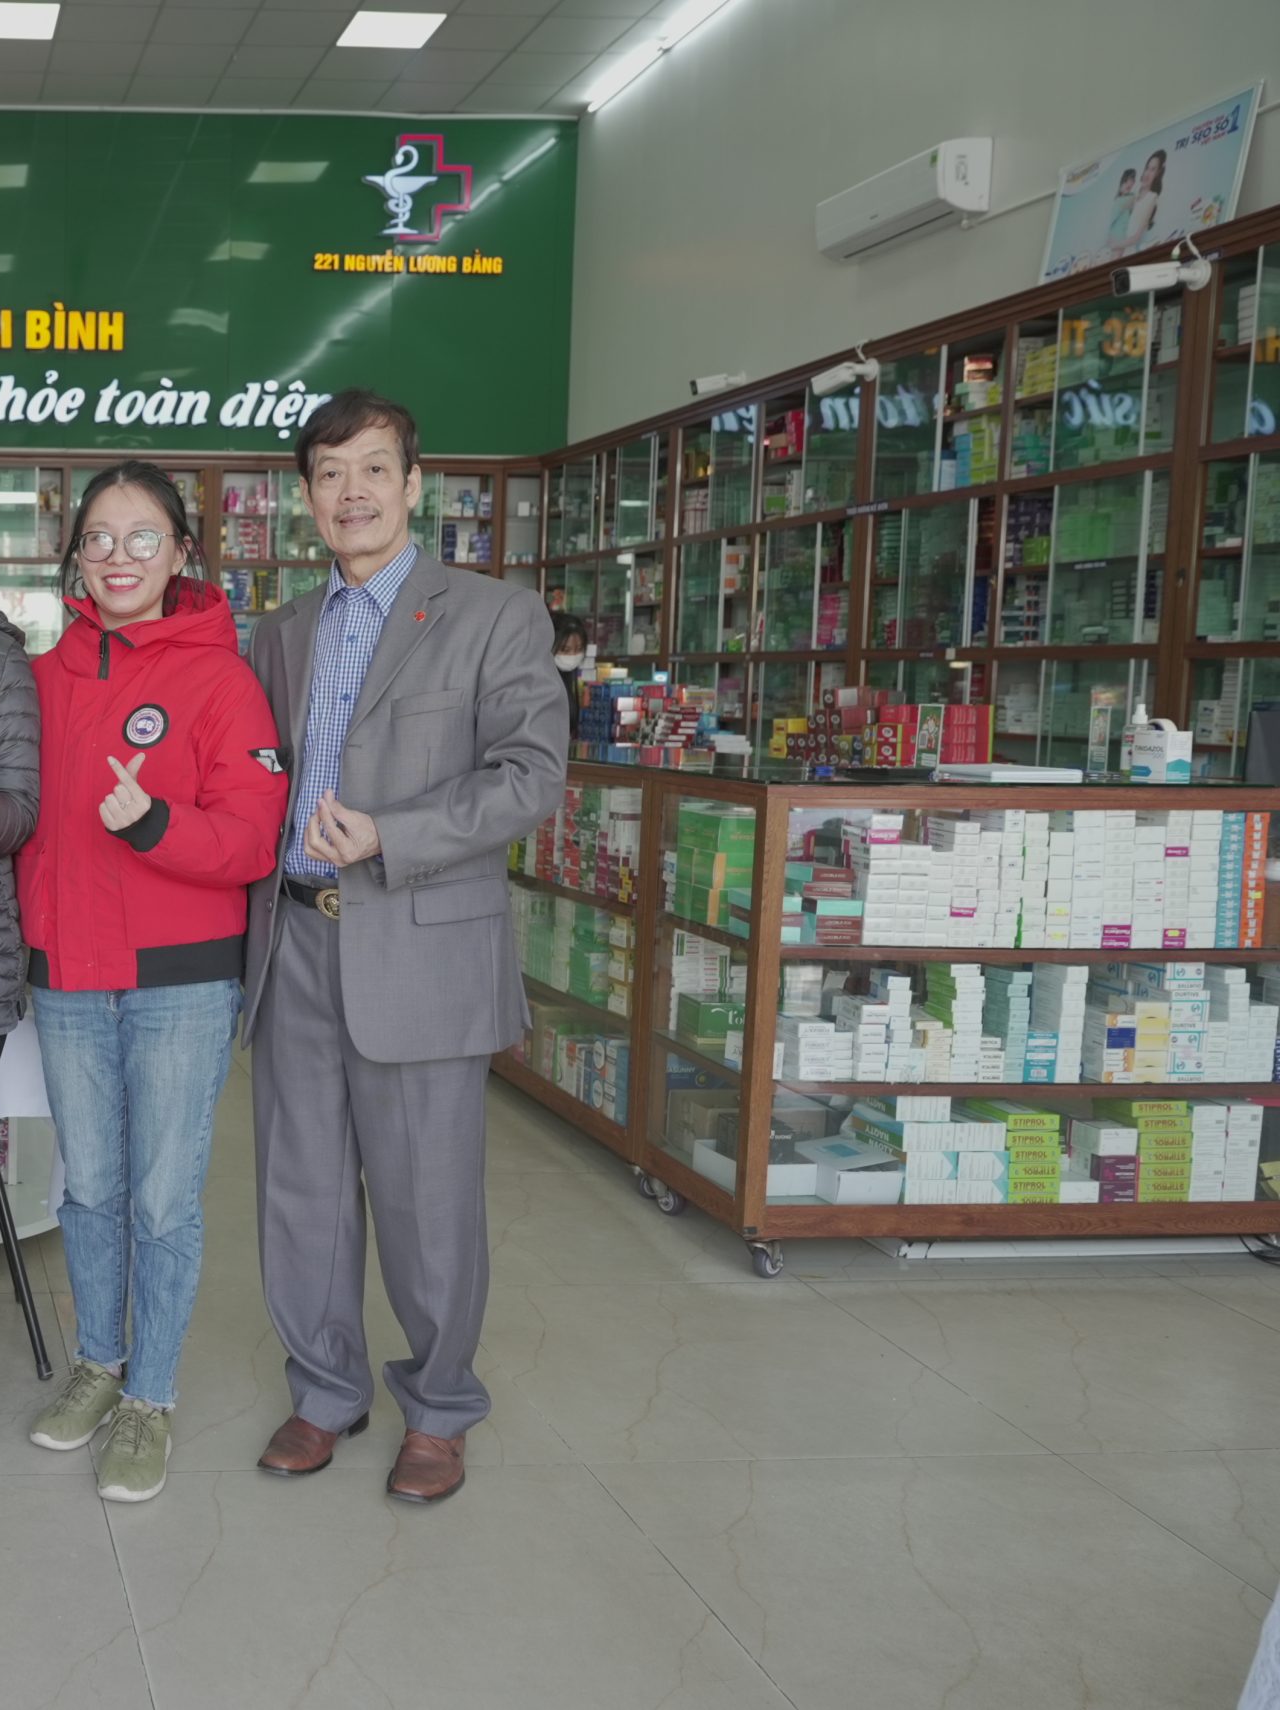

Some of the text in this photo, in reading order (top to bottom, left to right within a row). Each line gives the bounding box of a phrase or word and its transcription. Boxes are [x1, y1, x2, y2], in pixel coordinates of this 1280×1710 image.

[313, 253, 340, 270] 221
[25, 301, 125, 351] BÌNH
[94, 377, 211, 425] toàn
[1138, 1103, 1172, 1111] STIPROL
[1013, 1118, 1046, 1126] STIPROL
[1144, 1120, 1177, 1128] STIPROL
[1012, 1135, 1045, 1144] STIPROL
[1015, 1151, 1047, 1159] STIPROL
[1013, 1181, 1046, 1190] STIPROL
